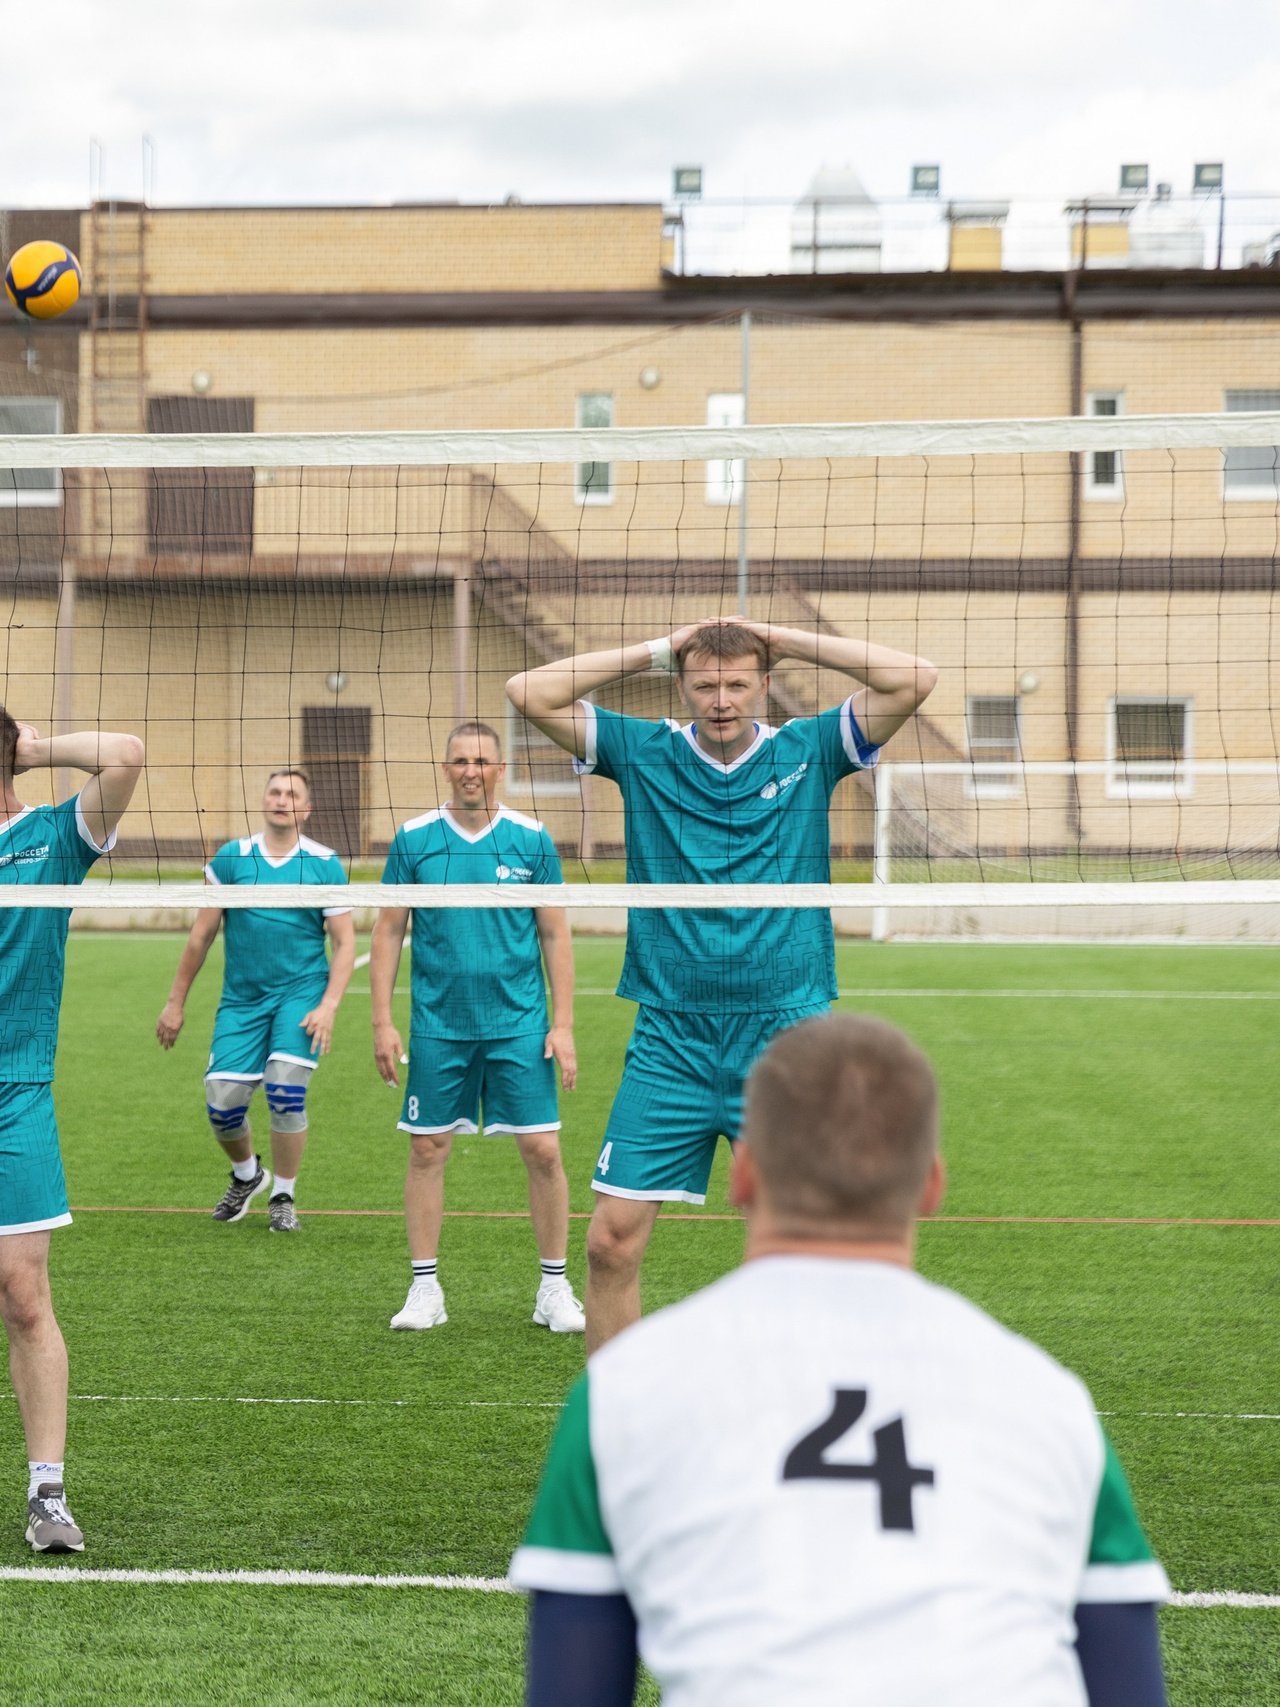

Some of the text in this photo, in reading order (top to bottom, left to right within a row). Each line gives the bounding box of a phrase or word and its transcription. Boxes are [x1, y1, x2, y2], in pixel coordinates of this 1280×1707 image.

[408, 1095, 420, 1121] 8
[597, 1141, 614, 1176] 4
[782, 1387, 934, 1531] 4
